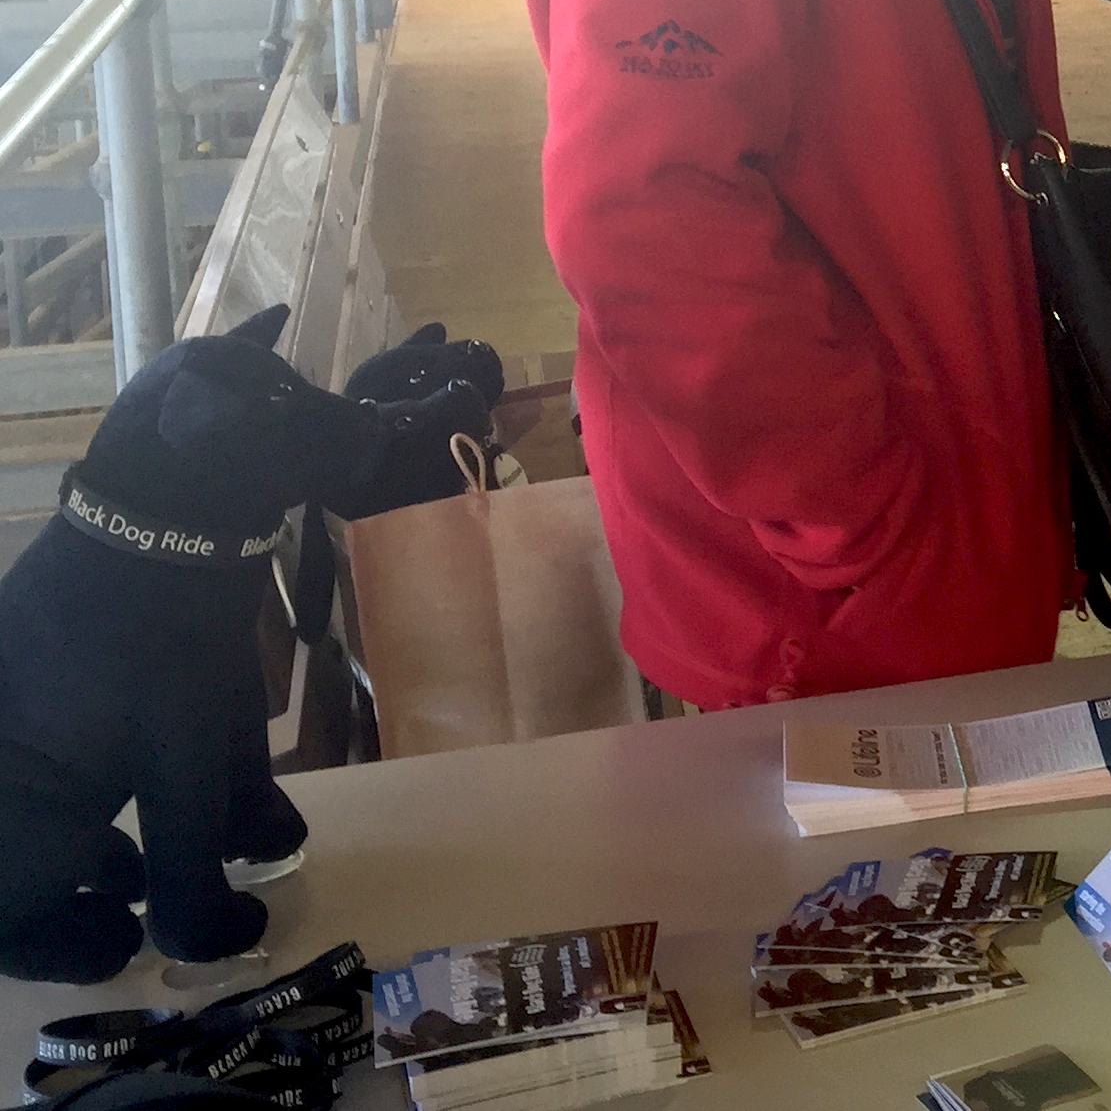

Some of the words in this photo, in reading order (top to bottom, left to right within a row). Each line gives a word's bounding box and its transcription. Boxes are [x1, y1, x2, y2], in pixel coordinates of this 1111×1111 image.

[67, 489, 105, 528] Black
[108, 513, 156, 550] Dog
[160, 530, 214, 557] Ride
[255, 986, 302, 1017] BLACK
[39, 1040, 65, 1061] BLACK
[69, 1044, 97, 1061] DOG
[208, 1040, 249, 1079] BLACK
